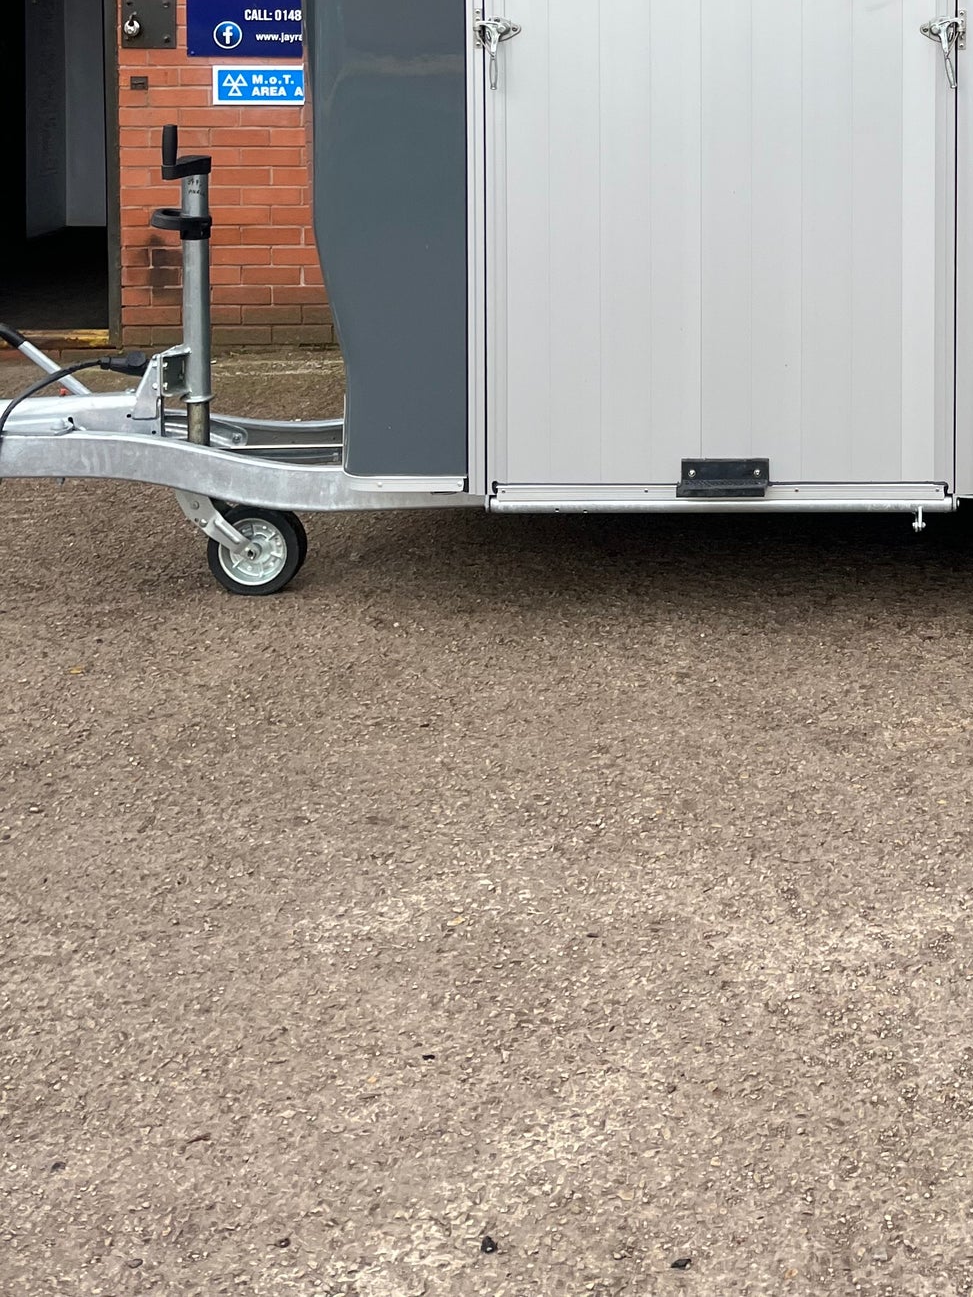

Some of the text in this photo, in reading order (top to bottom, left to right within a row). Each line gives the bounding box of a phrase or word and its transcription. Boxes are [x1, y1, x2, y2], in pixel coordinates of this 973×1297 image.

[244, 9, 302, 21] CALL: 0148
[252, 74, 295, 85] M.o.T.
[251, 86, 287, 97] AREA
